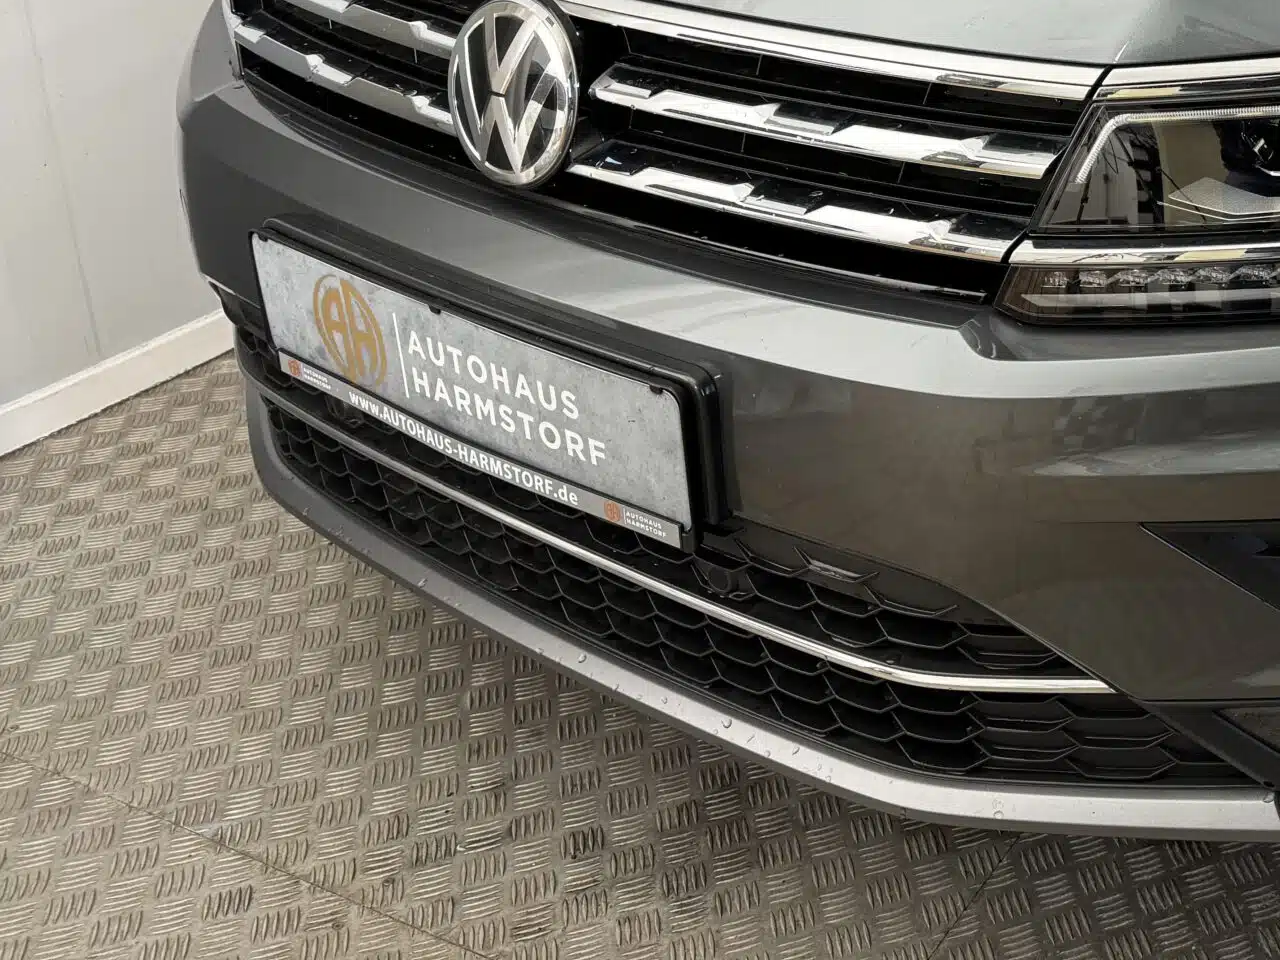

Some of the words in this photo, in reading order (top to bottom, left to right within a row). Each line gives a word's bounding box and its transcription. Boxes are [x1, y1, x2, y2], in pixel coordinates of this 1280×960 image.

[408, 330, 579, 420] AUTOHAUS
[411, 367, 607, 467] HARMSTORF
[348, 391, 579, 506] www.AUTOHAUS-HARMSTORF.de
